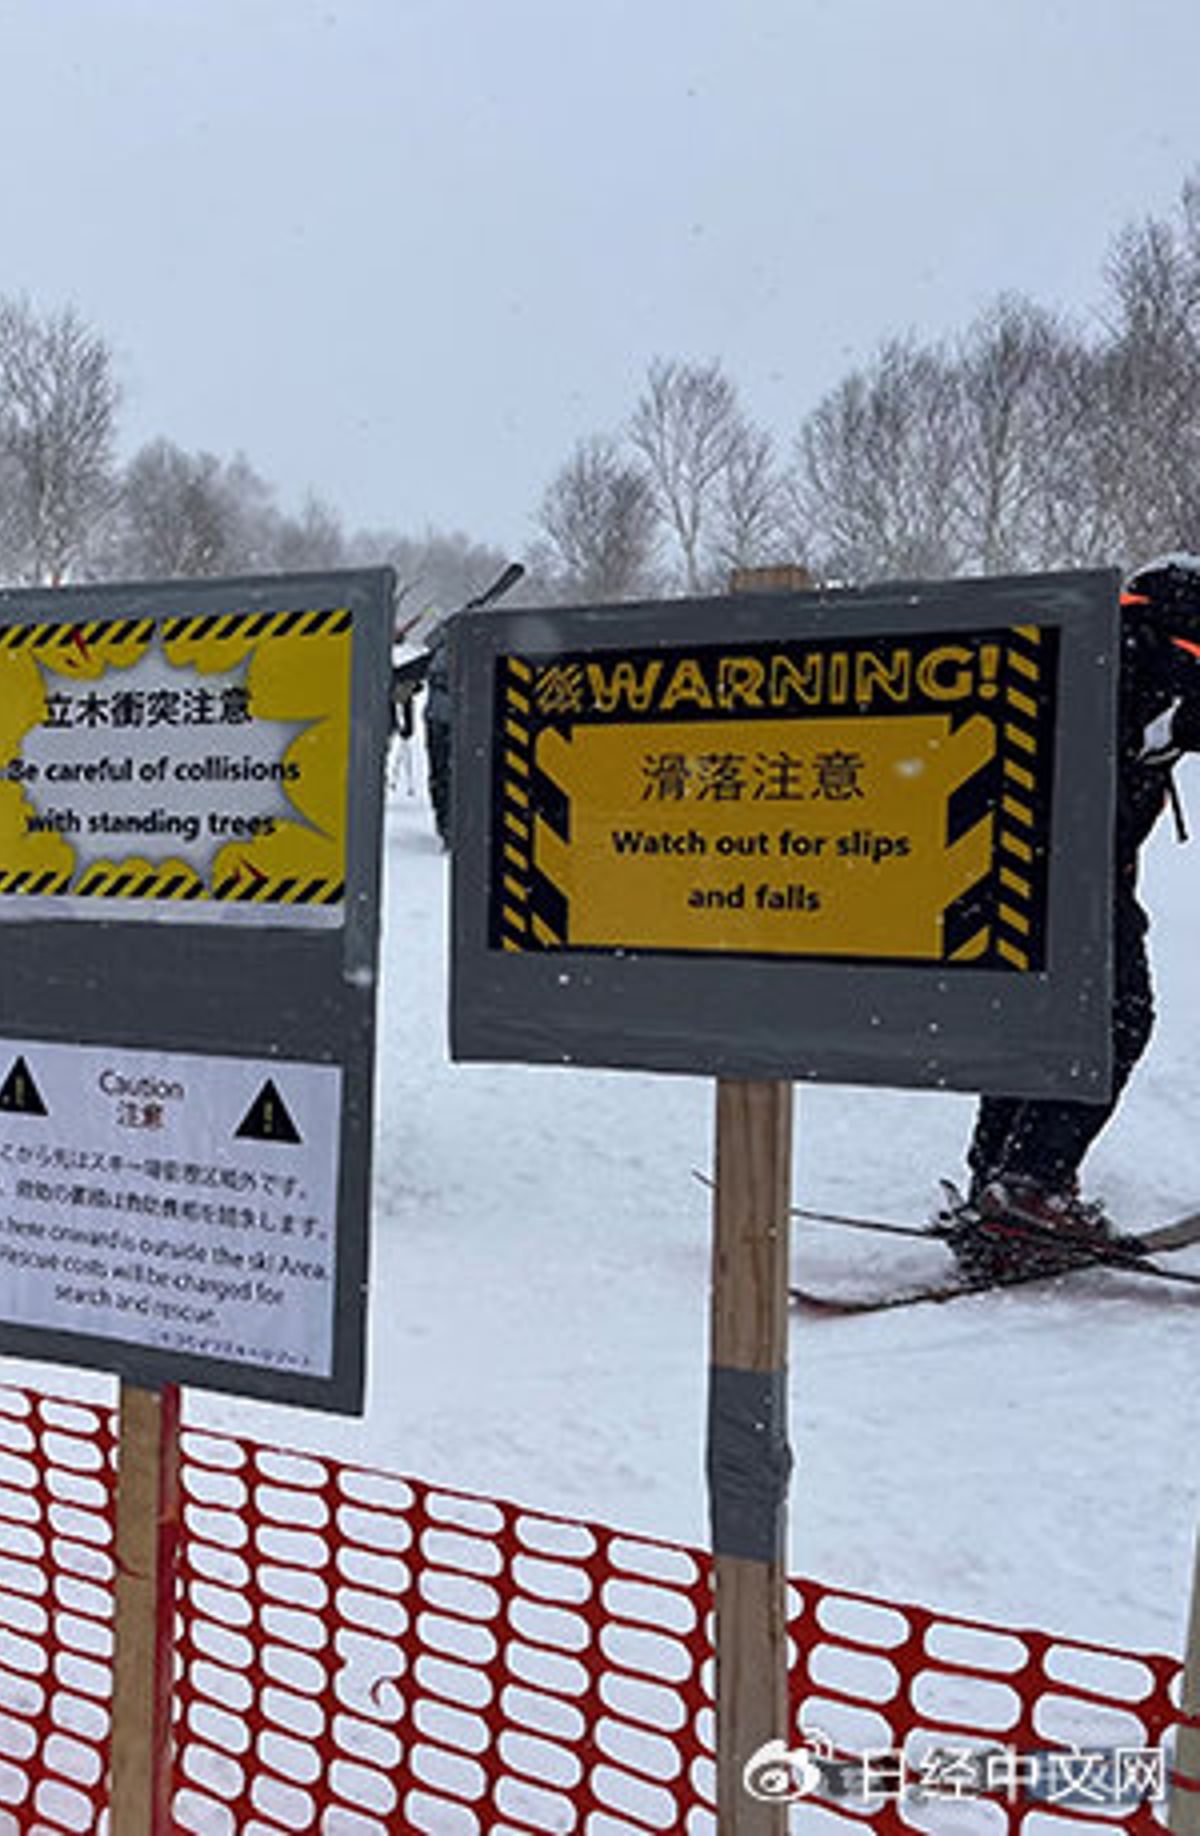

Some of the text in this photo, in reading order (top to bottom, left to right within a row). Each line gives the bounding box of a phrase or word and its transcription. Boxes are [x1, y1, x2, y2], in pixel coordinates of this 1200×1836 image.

[586, 646, 999, 711] WARNING!
[42, 687, 253, 729] 立木衝突注意
[7, 755, 300, 783] Be careful of collisions
[641, 750, 866, 801] 滑落注意
[27, 808, 277, 841] with standing trees
[612, 829, 912, 864] Watch out for slips
[687, 884, 822, 912] and falls
[99, 1068, 185, 1099] Caution
[139, 1238, 207, 1264] outside
[211, 1247, 245, 1269] the
[147, 1266, 170, 1287] be
[173, 1271, 252, 1302] charged
[255, 1279, 285, 1305] for
[115, 1291, 149, 1315] and
